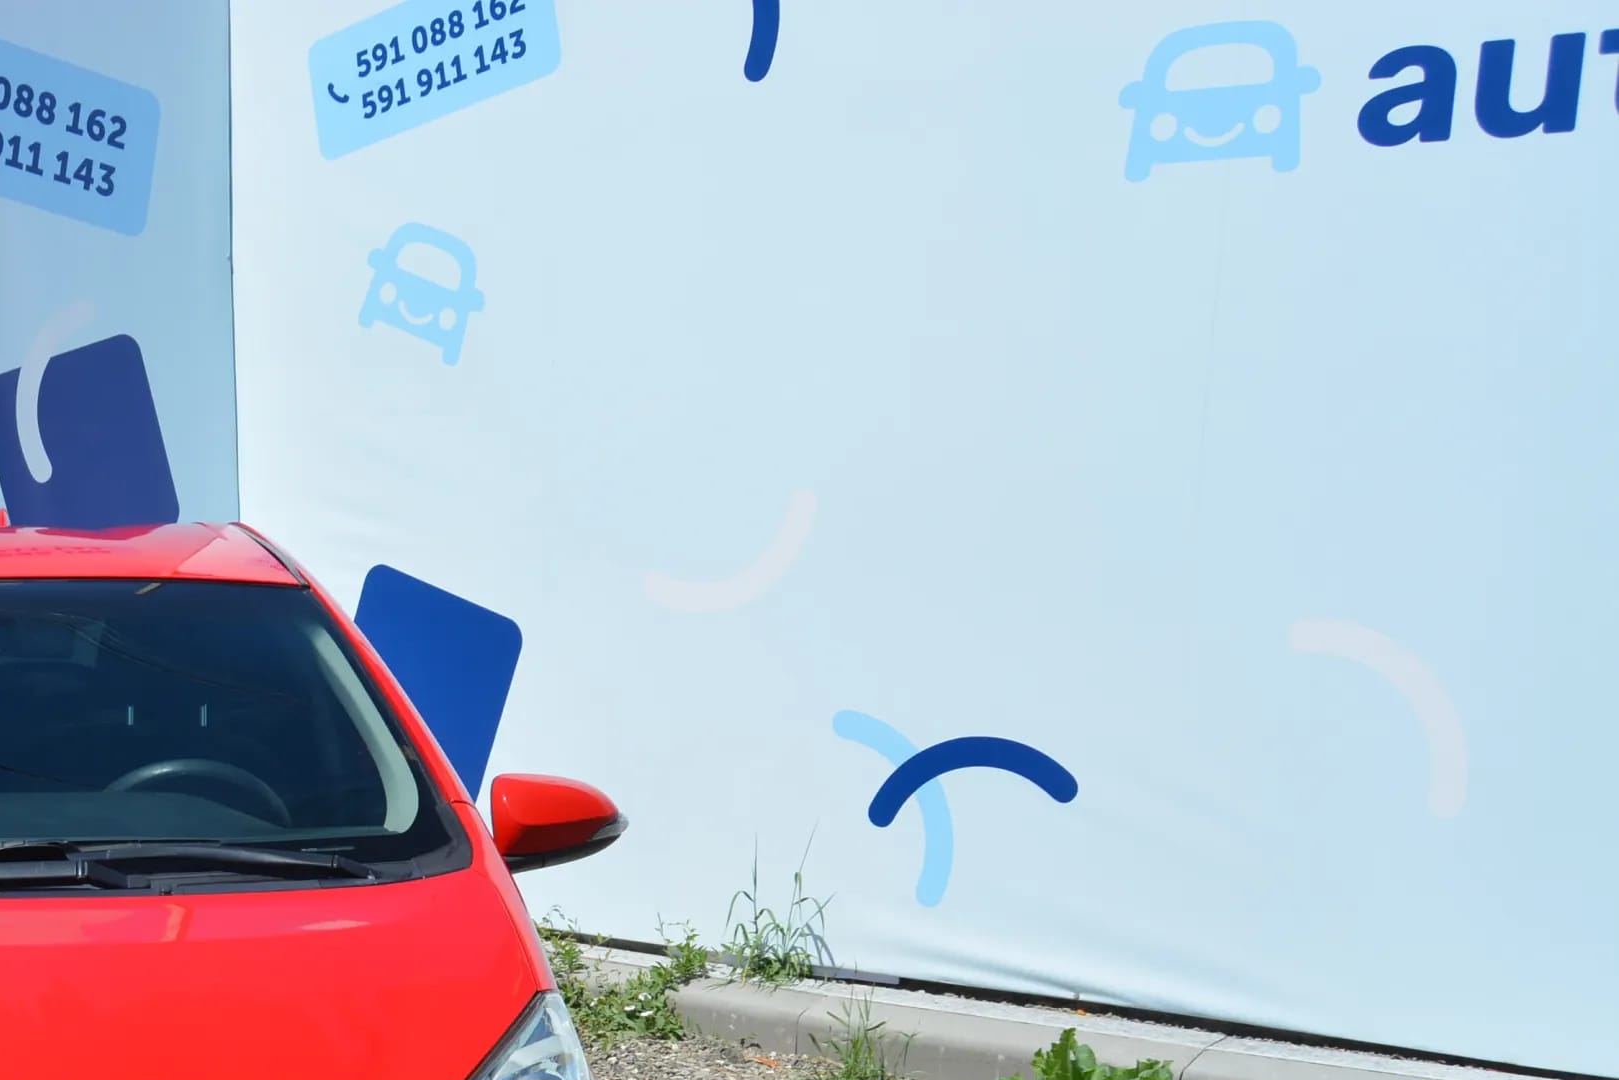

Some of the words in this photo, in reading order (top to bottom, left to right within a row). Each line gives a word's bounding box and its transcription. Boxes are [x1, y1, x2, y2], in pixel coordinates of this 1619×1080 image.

[356, 36, 406, 78] 591
[412, 10, 465, 54] 088
[361, 78, 411, 119] 591
[417, 54, 468, 98] 911
[474, 29, 527, 75] 143
[1357, 28, 1619, 147] au
[65, 102, 127, 150] 162
[53, 151, 116, 197] 143
